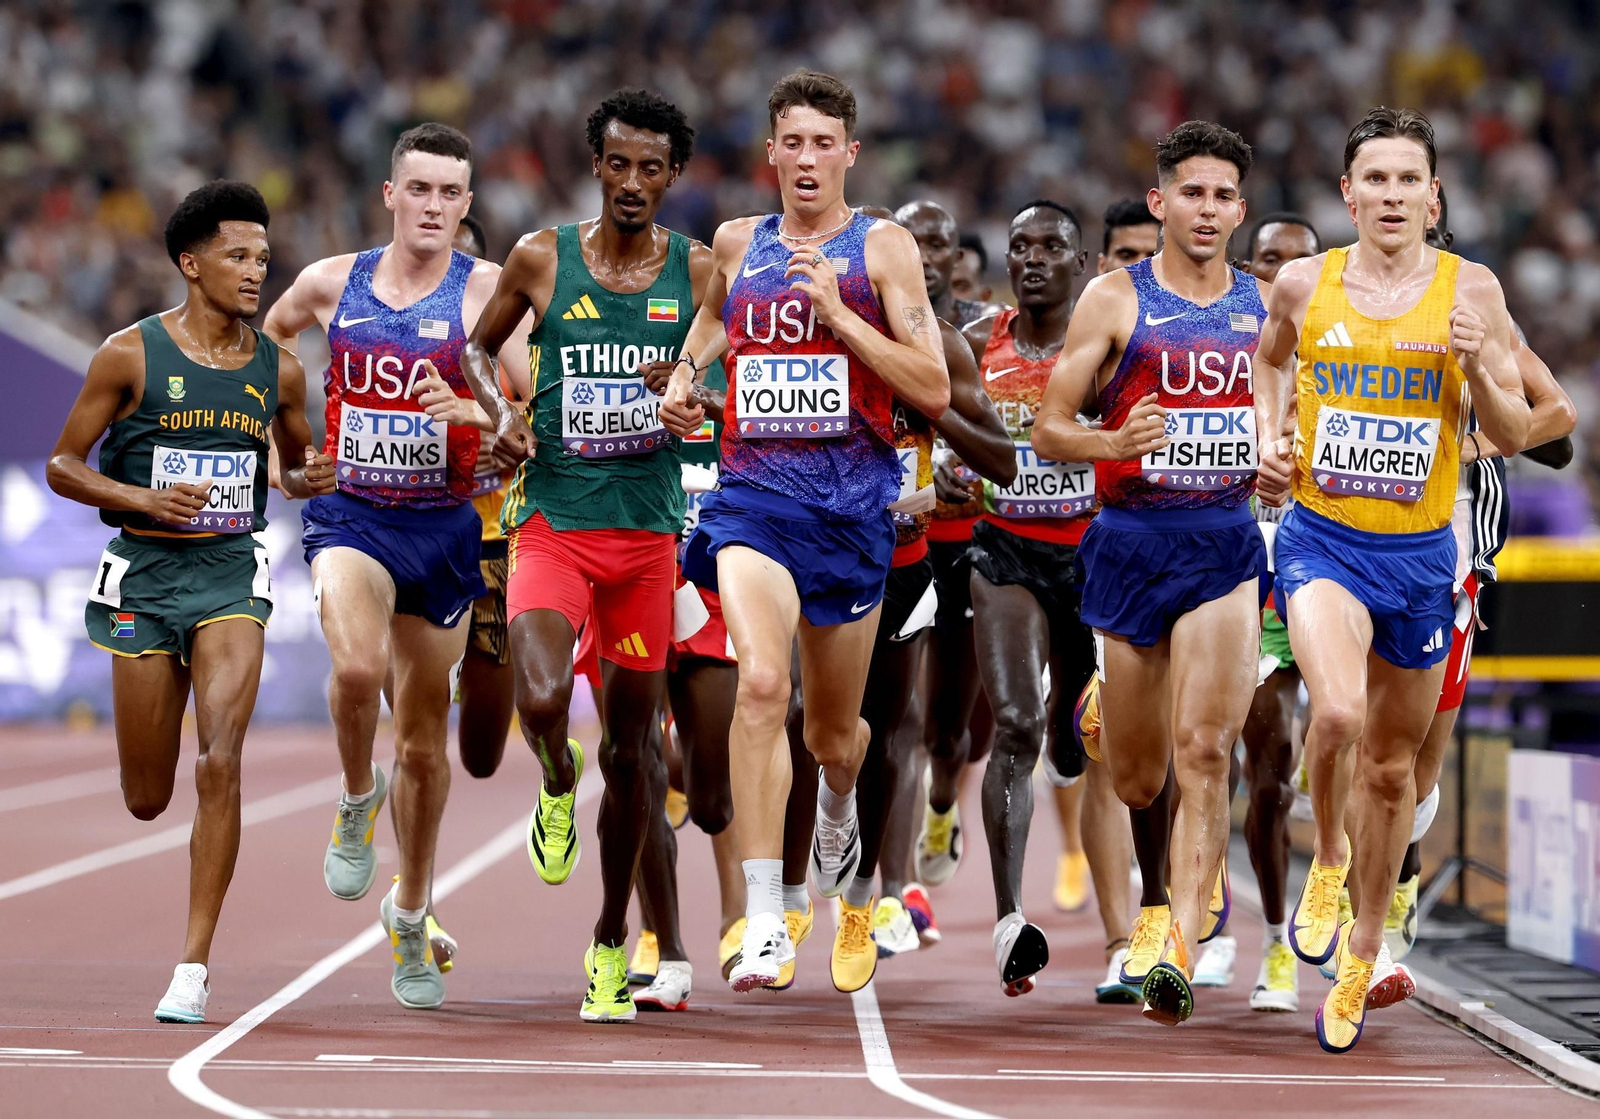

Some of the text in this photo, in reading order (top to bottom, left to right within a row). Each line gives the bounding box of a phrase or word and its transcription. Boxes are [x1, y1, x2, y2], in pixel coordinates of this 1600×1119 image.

[560, 344, 675, 375] ETHIOPI
[1395, 342, 1448, 354] BAUHAUS
[763, 359, 838, 382] TDK
[1161, 351, 1253, 396] USA
[1313, 361, 1443, 403] SWEDEN
[741, 388, 841, 413] YOUNG
[160, 409, 214, 430] SOUTH
[364, 413, 438, 438] TDK
[1179, 411, 1249, 435] TDK
[1350, 415, 1430, 446] TDK
[344, 436, 440, 467] BLANKS
[1150, 442, 1251, 466] FISHER
[1319, 442, 1431, 477] ALMGREN
[187, 453, 251, 478] TDK
